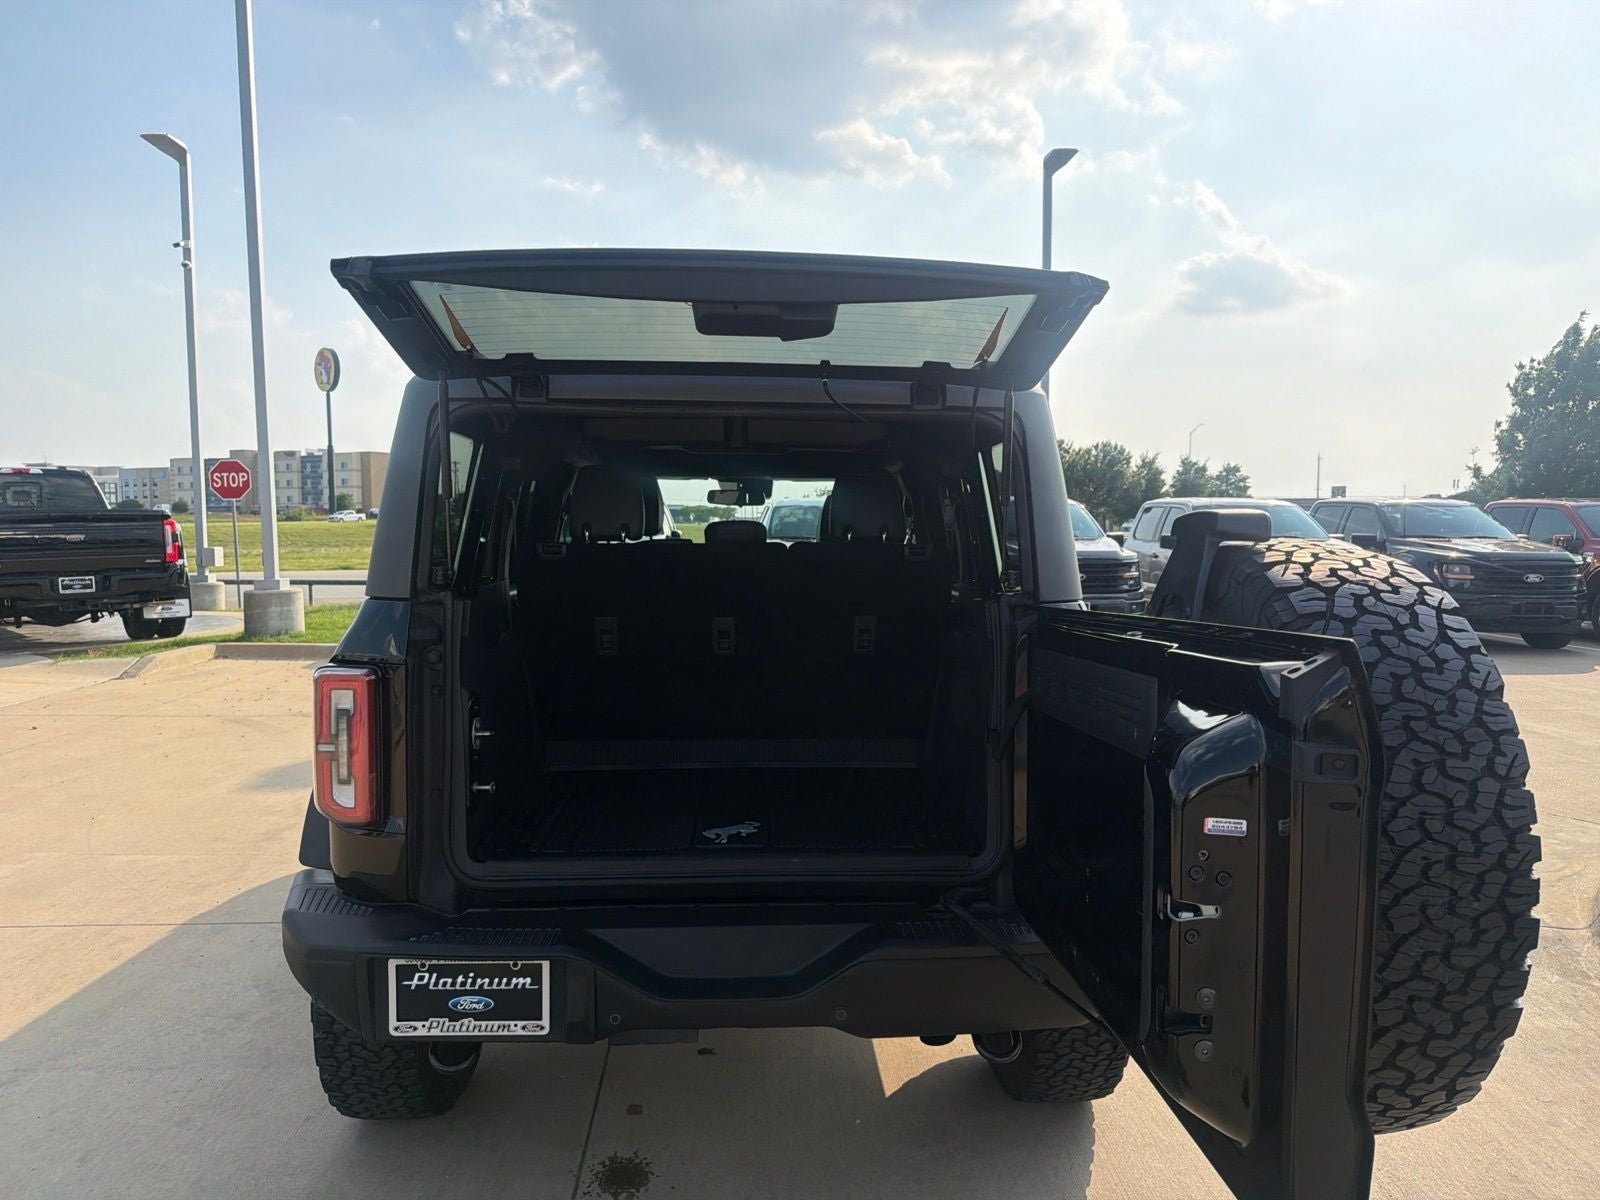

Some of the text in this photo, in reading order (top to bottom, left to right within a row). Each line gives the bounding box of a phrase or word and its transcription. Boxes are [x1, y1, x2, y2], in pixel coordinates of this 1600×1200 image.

[213, 472, 248, 488] STOP
[402, 972, 539, 990] Platinum
[428, 1019, 518, 1033] Platinum
